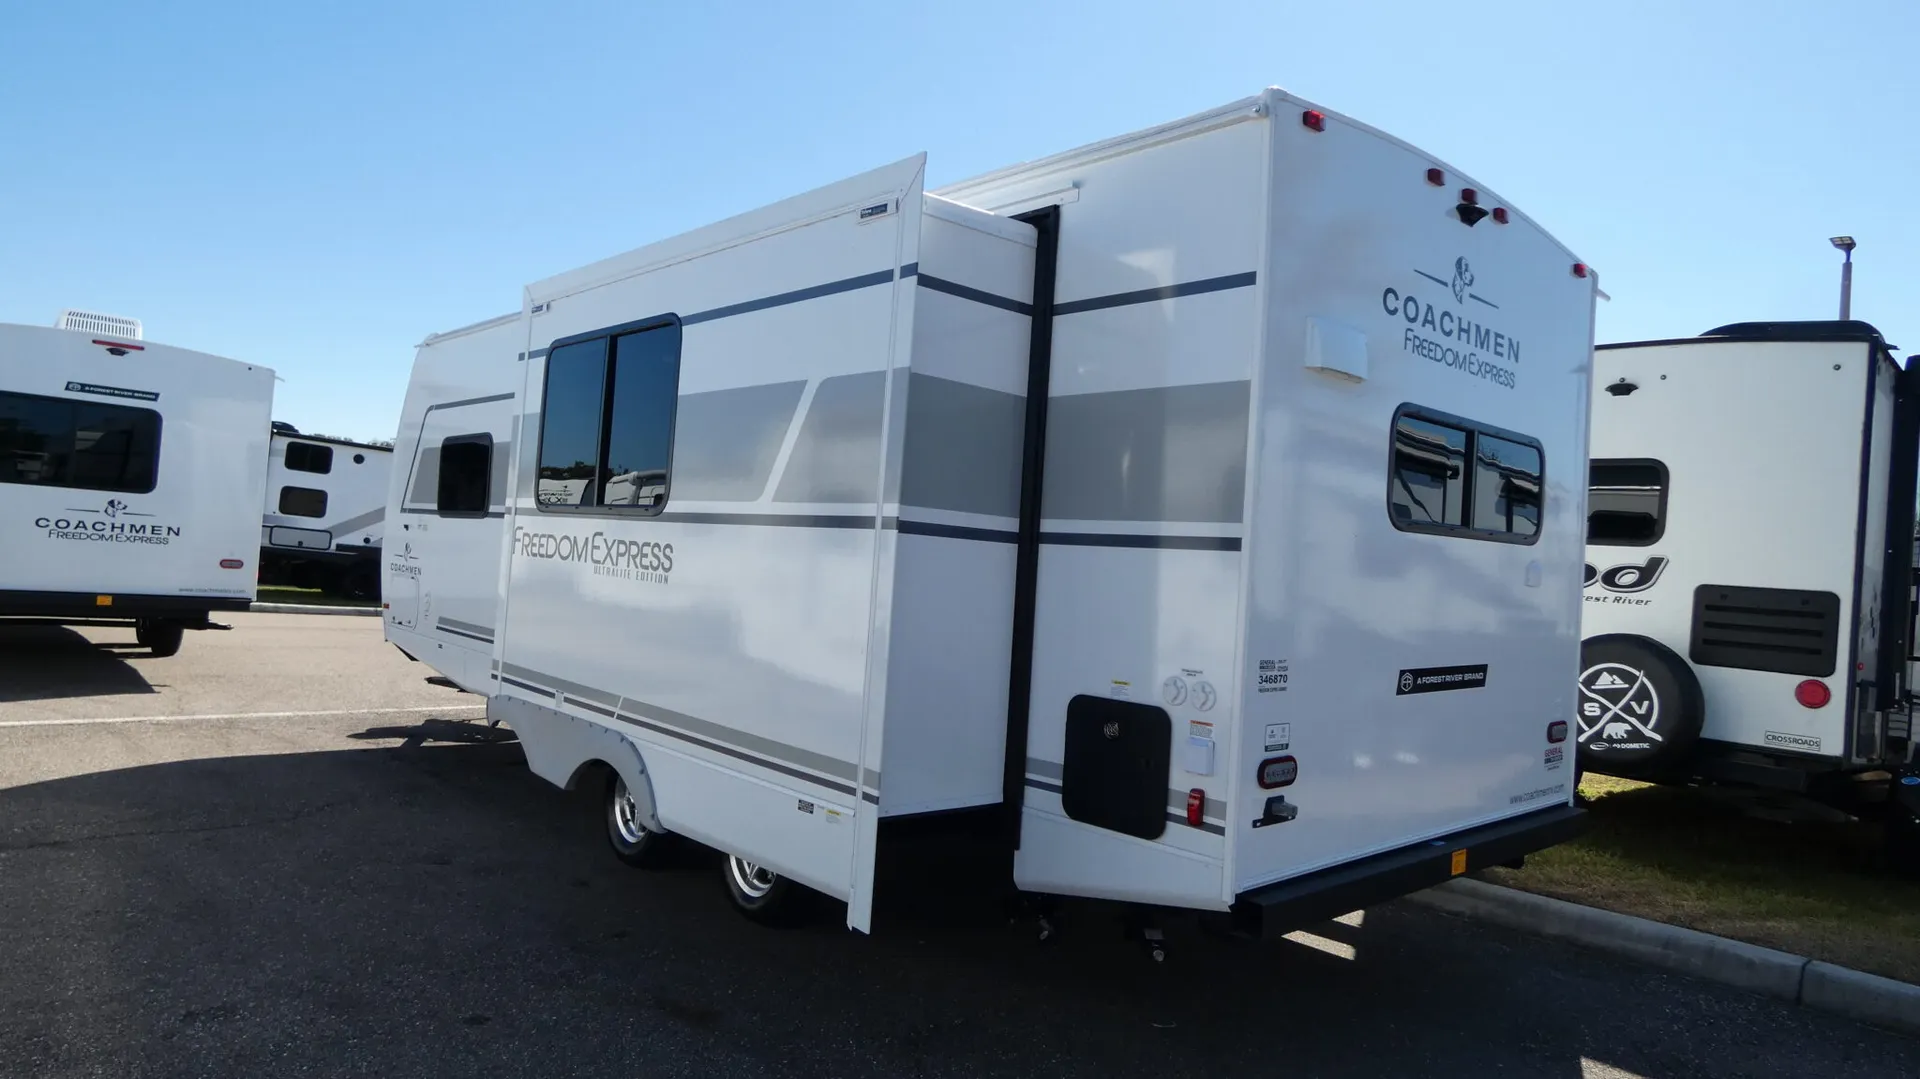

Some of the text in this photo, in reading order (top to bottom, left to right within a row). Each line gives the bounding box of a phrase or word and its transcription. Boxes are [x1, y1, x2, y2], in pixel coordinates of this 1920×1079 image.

[1383, 287, 1520, 363] COACHMEN
[35, 517, 181, 537] COACHMEN
[391, 563, 421, 575] COACHMEN
[593, 565, 669, 585] ULTRALITE EDITION
[1612, 595, 1652, 606] River
[1258, 674, 1288, 684] 346870
[1422, 675, 1445, 684] FOREST
[1445, 674, 1463, 682] RIVER
[1463, 672, 1484, 681] BRAND
[1583, 700, 1649, 716] S V
[1765, 734, 1820, 747] CROSSROADS
